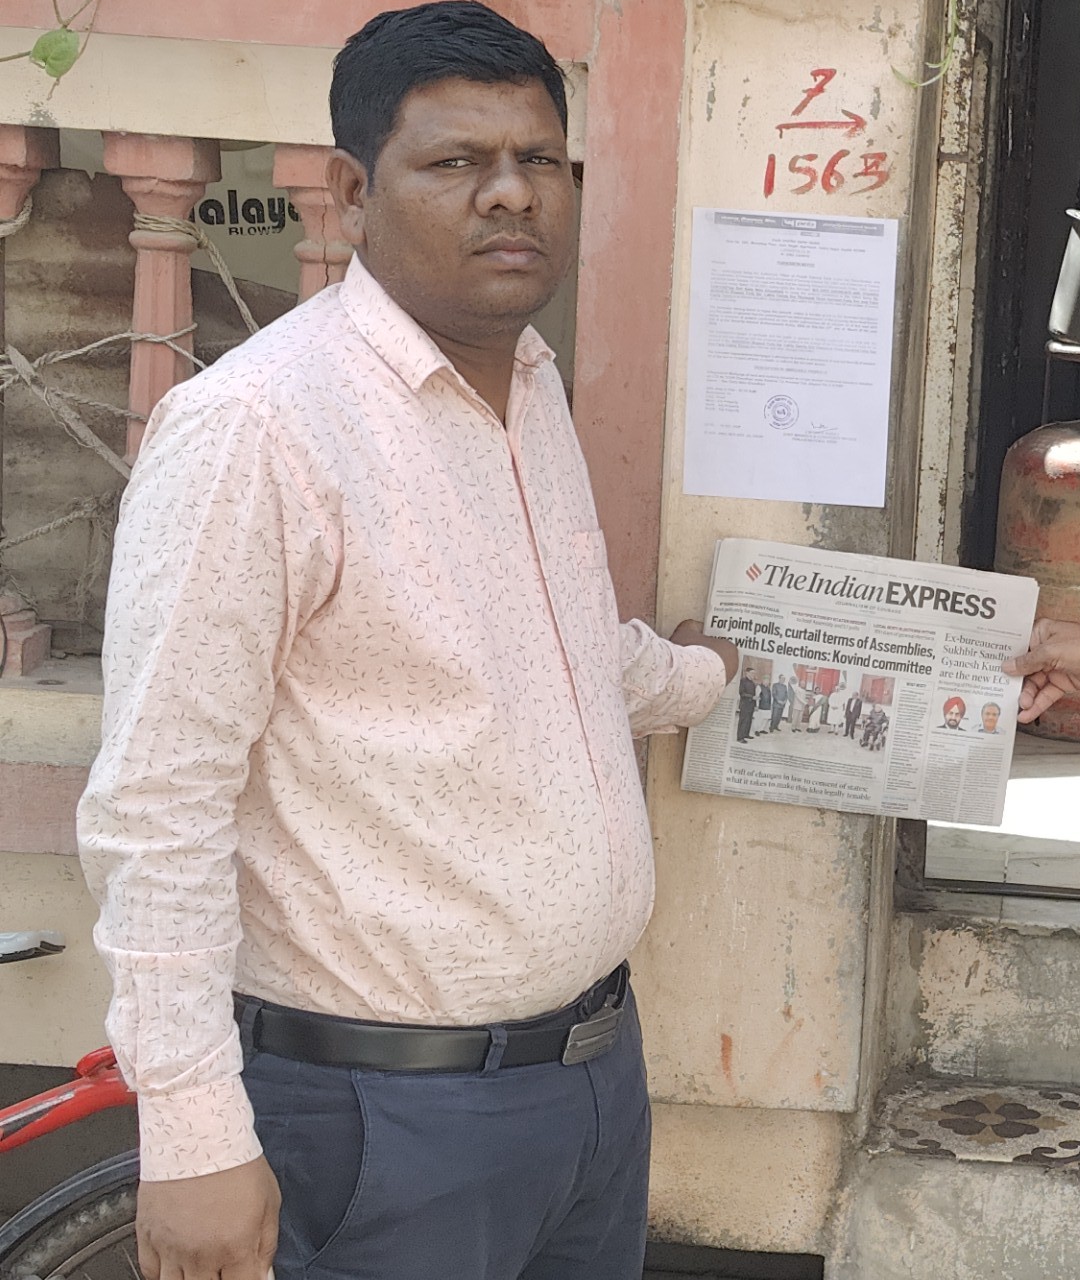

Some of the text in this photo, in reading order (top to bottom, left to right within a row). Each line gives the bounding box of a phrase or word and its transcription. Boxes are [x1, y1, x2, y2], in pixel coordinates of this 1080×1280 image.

[791, 68, 837, 117] 7
[764, 563, 807, 591] The
[806, 571, 884, 603] Indian
[885, 581, 997, 620] EXPRESS
[711, 615, 727, 630] For
[727, 617, 753, 632] joint
[753, 621, 783, 638] polls,
[784, 627, 821, 642] curtail
[823, 632, 856, 647] terms
[856, 637, 870, 649] of
[869, 638, 936, 660] Assemblies,
[943, 645, 978, 657] Sukhbir
[944, 632, 1013, 652] Ex-bureaucrats
[734, 636, 760, 651] with
[761, 639, 776, 653] LS
[776, 643, 831, 662] elections:
[832, 650, 871, 669] Kovind
[872, 658, 933, 676] committee
[941, 656, 1002, 674] Gyanesh Kum
[939, 670, 954, 679] are
[955, 670, 971, 681] the
[972, 674, 990, 683] new
